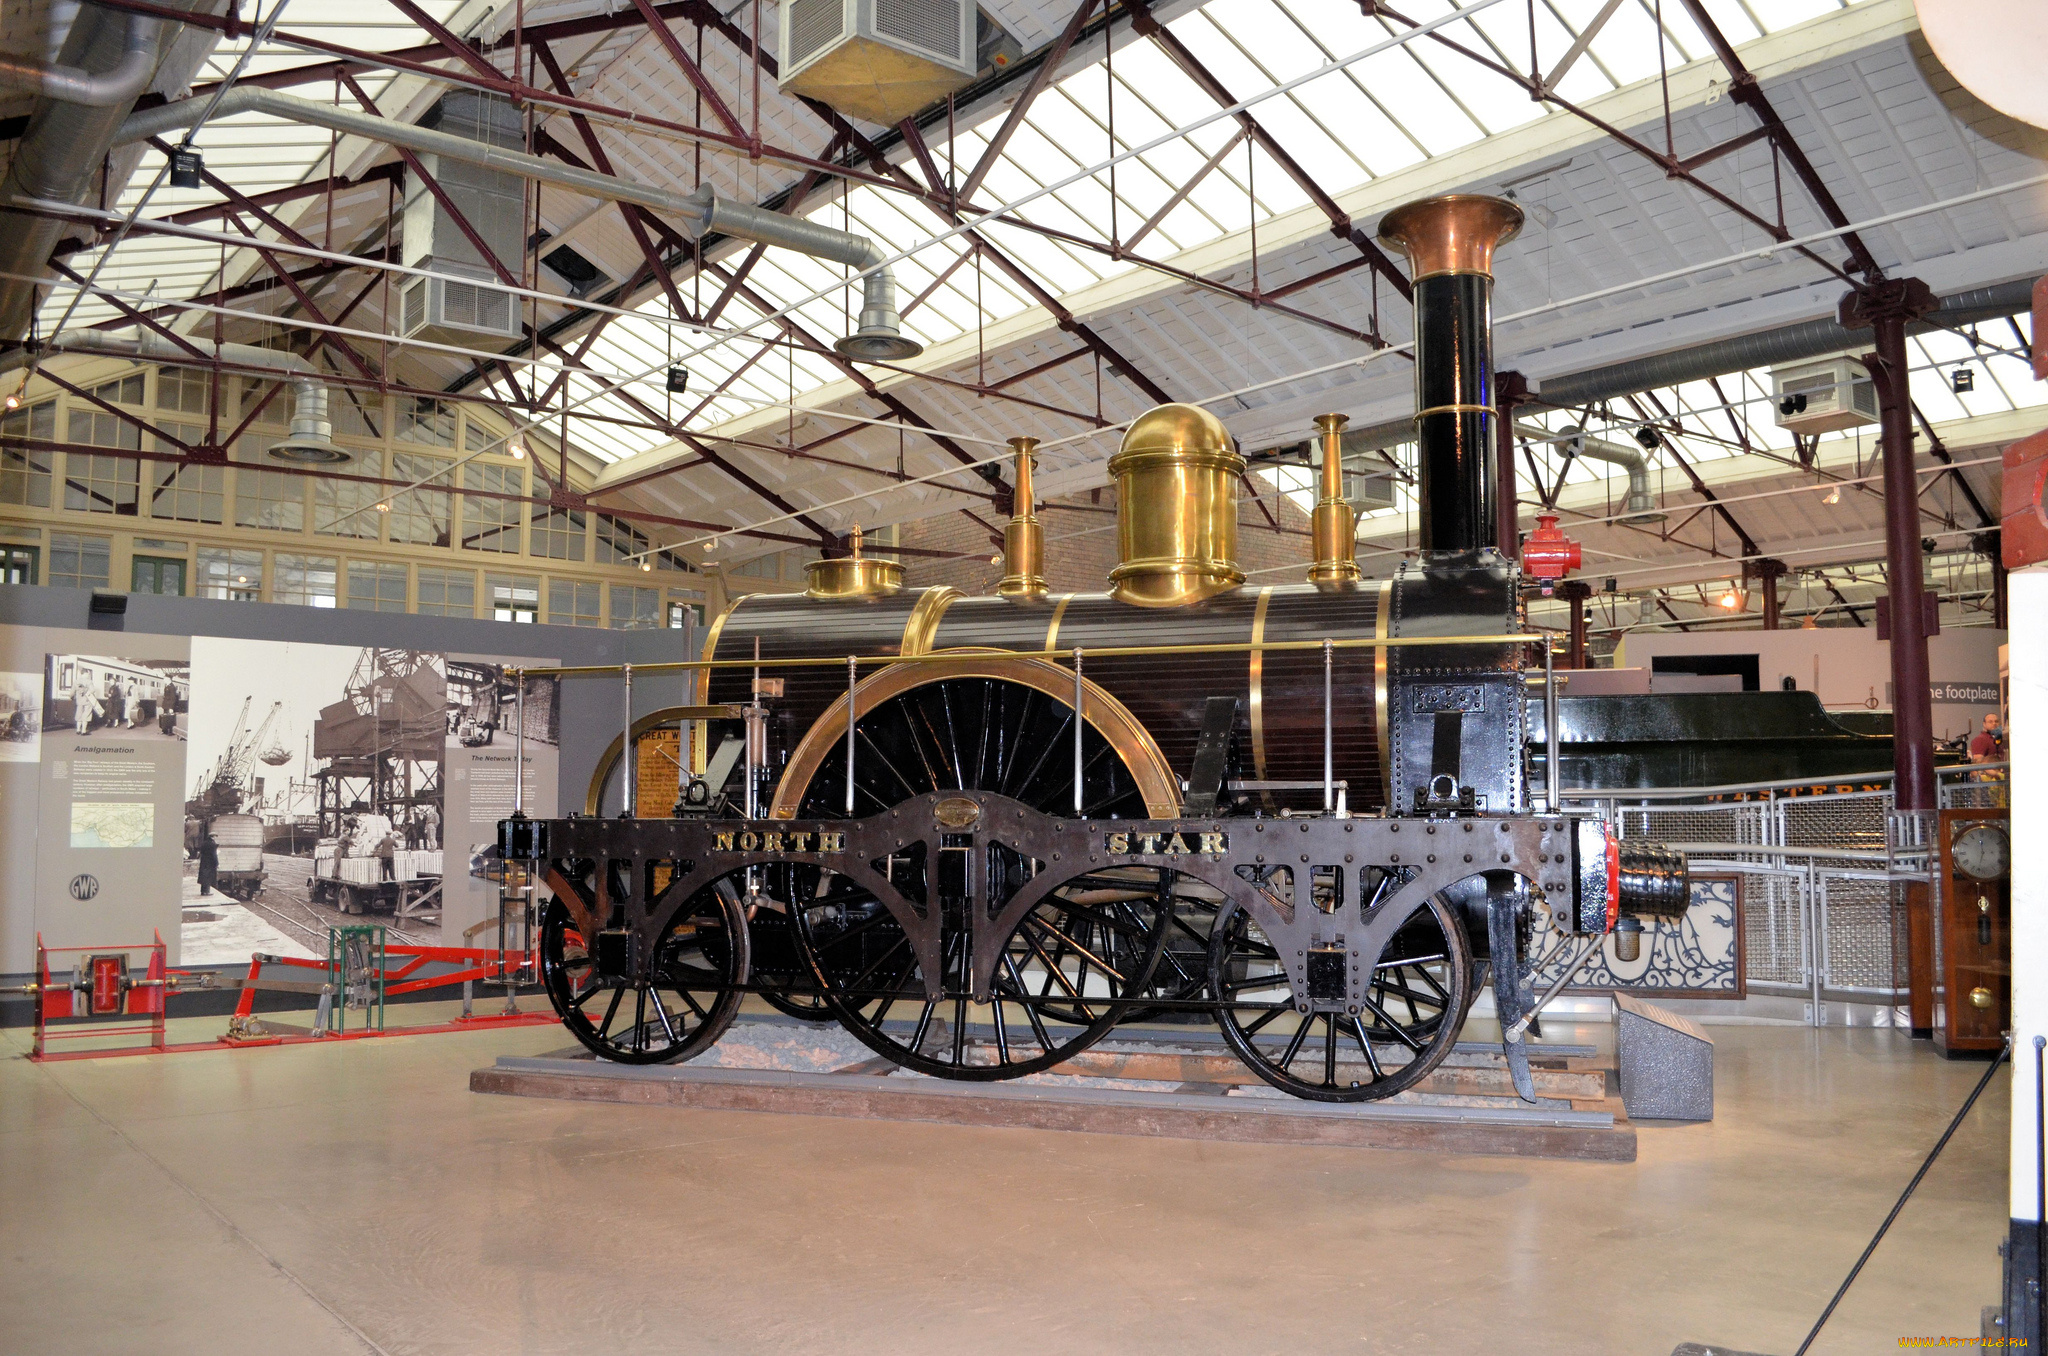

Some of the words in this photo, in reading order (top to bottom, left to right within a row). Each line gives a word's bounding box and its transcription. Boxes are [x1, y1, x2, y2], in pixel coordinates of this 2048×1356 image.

[1946, 684, 1998, 702] footplate
[74, 745, 135, 754] Amalgamation
[712, 831, 844, 852] NORTH
[1107, 832, 1227, 854] STAR
[71, 875, 98, 900] GWR
